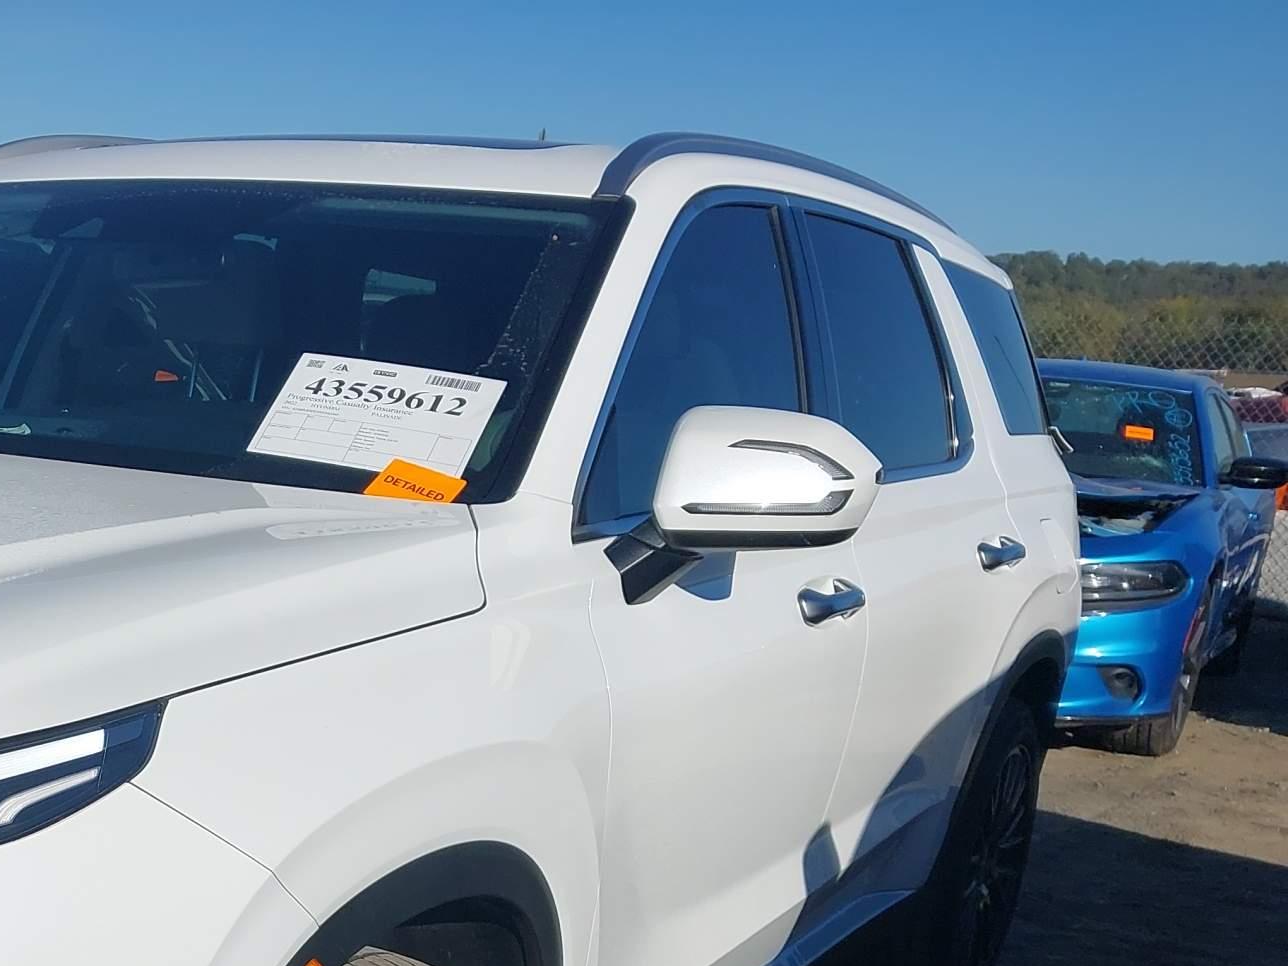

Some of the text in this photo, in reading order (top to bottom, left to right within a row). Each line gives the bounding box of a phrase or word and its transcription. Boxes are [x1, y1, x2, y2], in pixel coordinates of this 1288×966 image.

[287, 392, 414, 415] Progressive Casualty Insurance
[305, 377, 467, 416] 43559612
[383, 474, 445, 501] DETAILED
